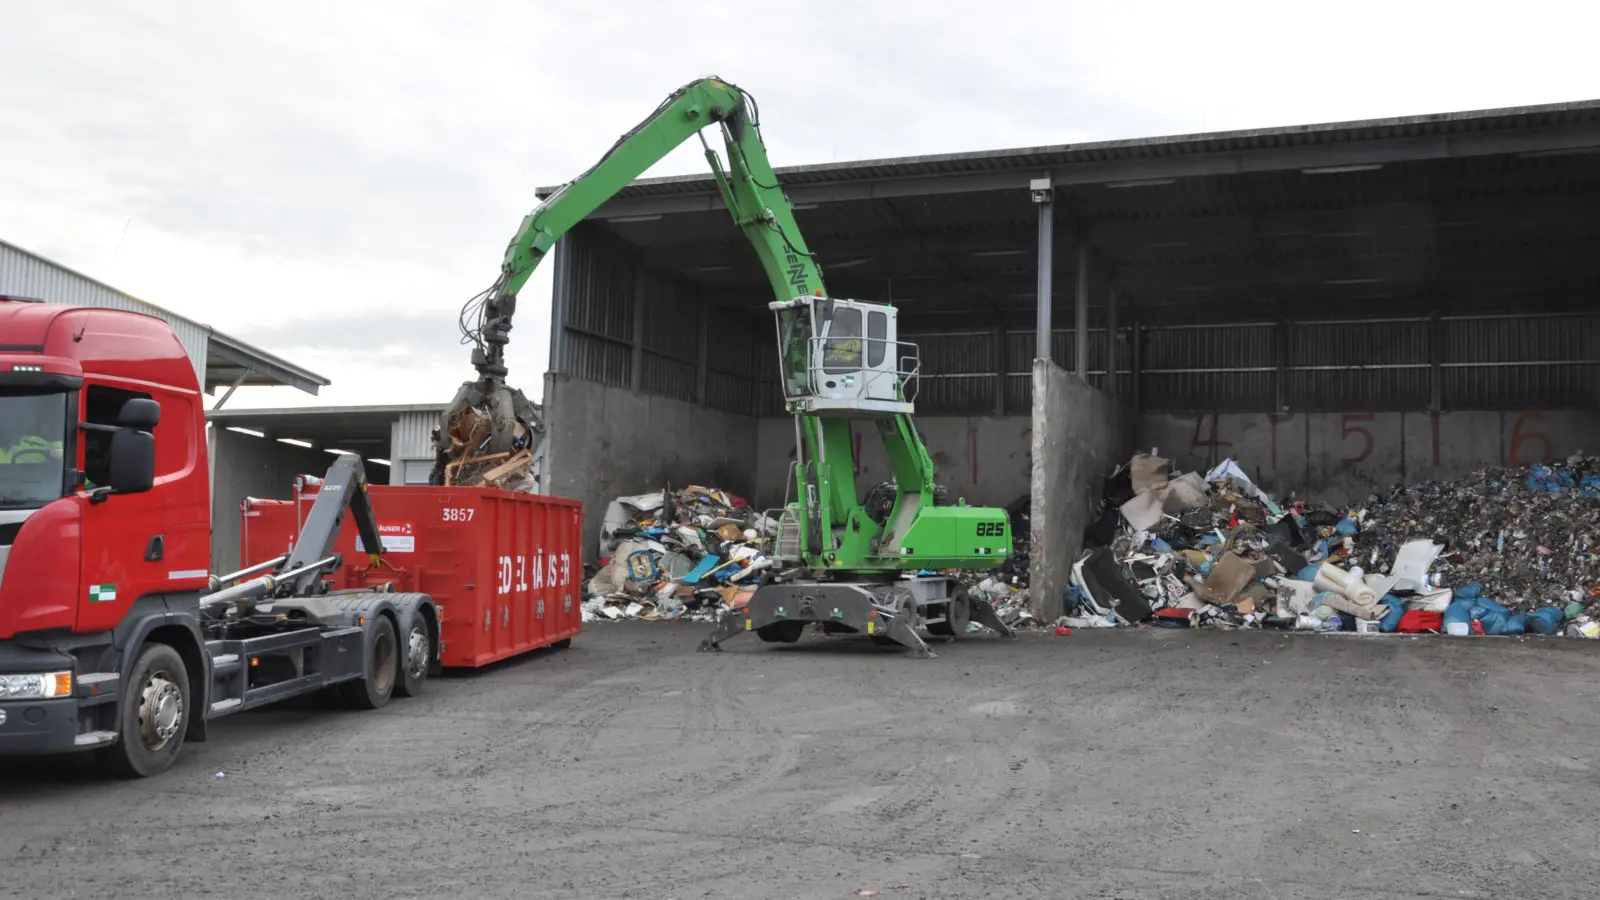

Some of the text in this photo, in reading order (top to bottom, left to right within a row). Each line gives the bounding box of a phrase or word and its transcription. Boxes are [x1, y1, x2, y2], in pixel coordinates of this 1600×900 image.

[783, 244, 810, 297] SENNE
[1340, 413, 1376, 463] 5
[1510, 411, 1554, 469] 6
[442, 507, 475, 522] 3857
[378, 524, 401, 532] ÄUSER
[976, 522, 1005, 537] 825
